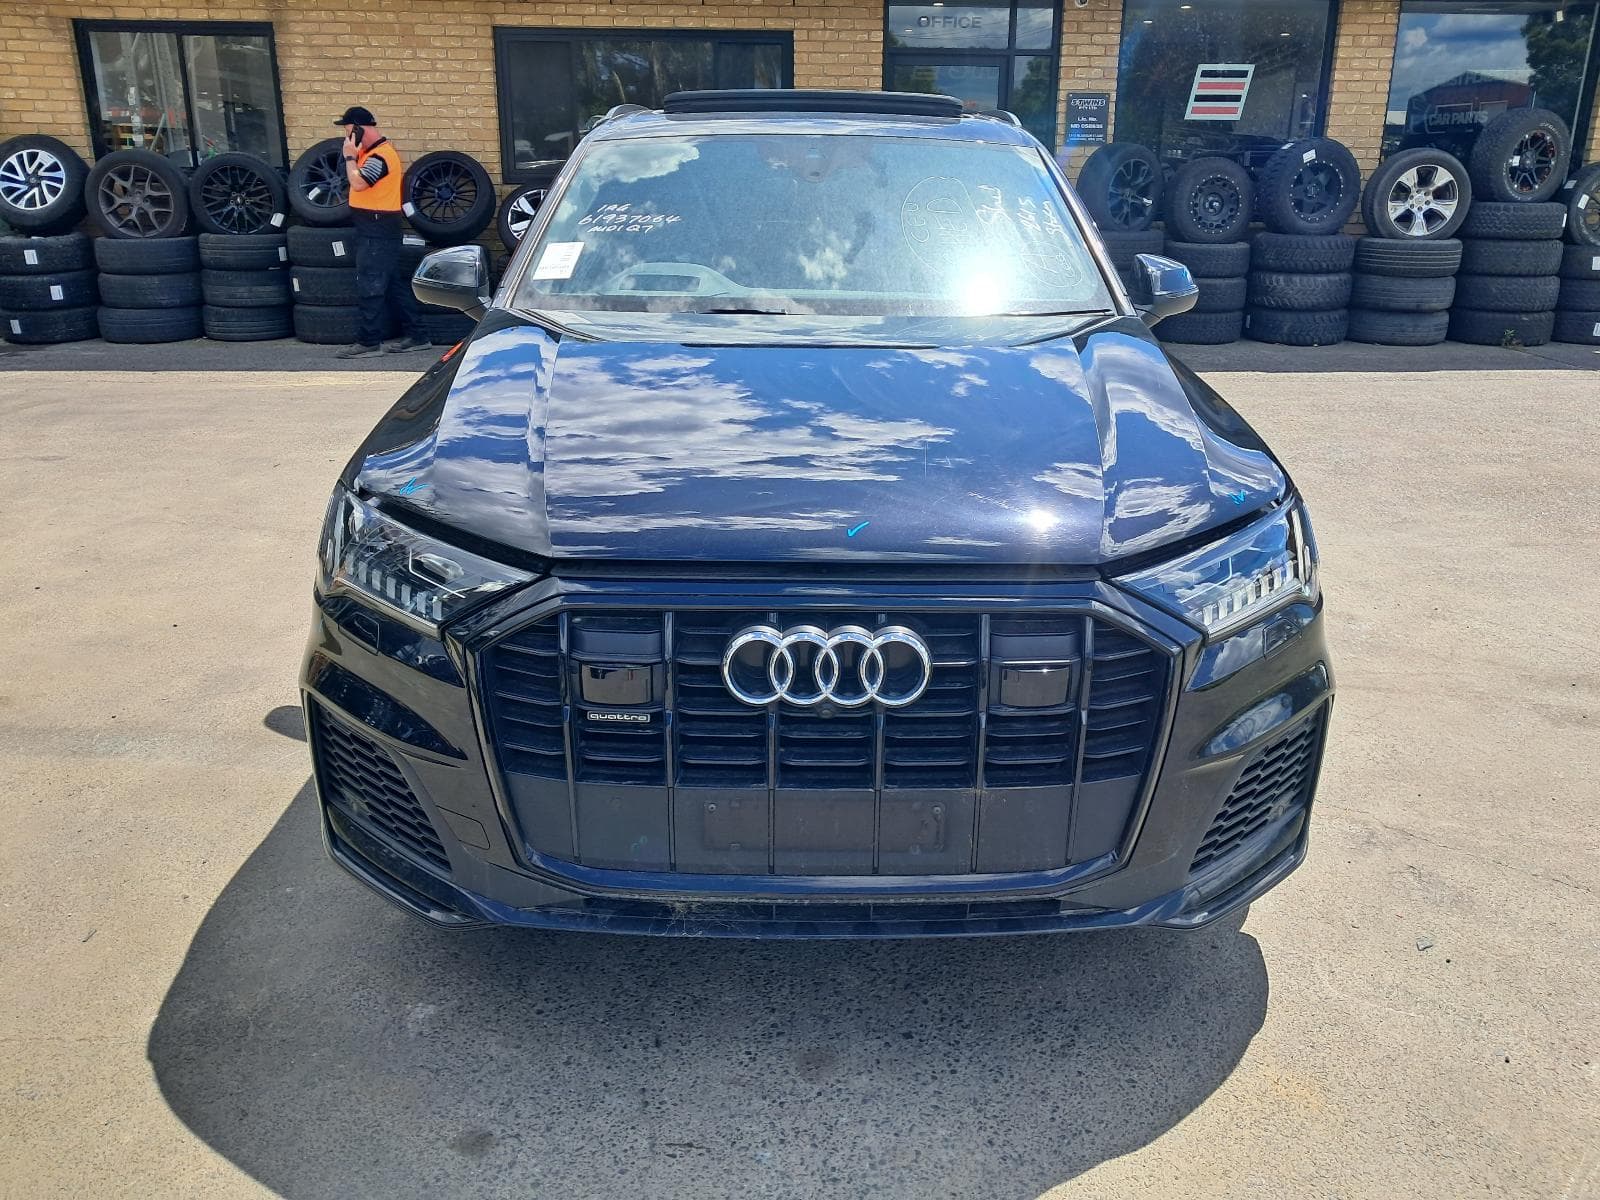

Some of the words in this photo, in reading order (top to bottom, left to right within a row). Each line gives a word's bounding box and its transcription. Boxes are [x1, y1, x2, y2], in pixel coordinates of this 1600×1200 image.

[917, 15, 982, 28] OFFICE
[1429, 113, 1450, 126] CAR
[1451, 111, 1489, 124] PARTS
[590, 713, 647, 721] quattro
